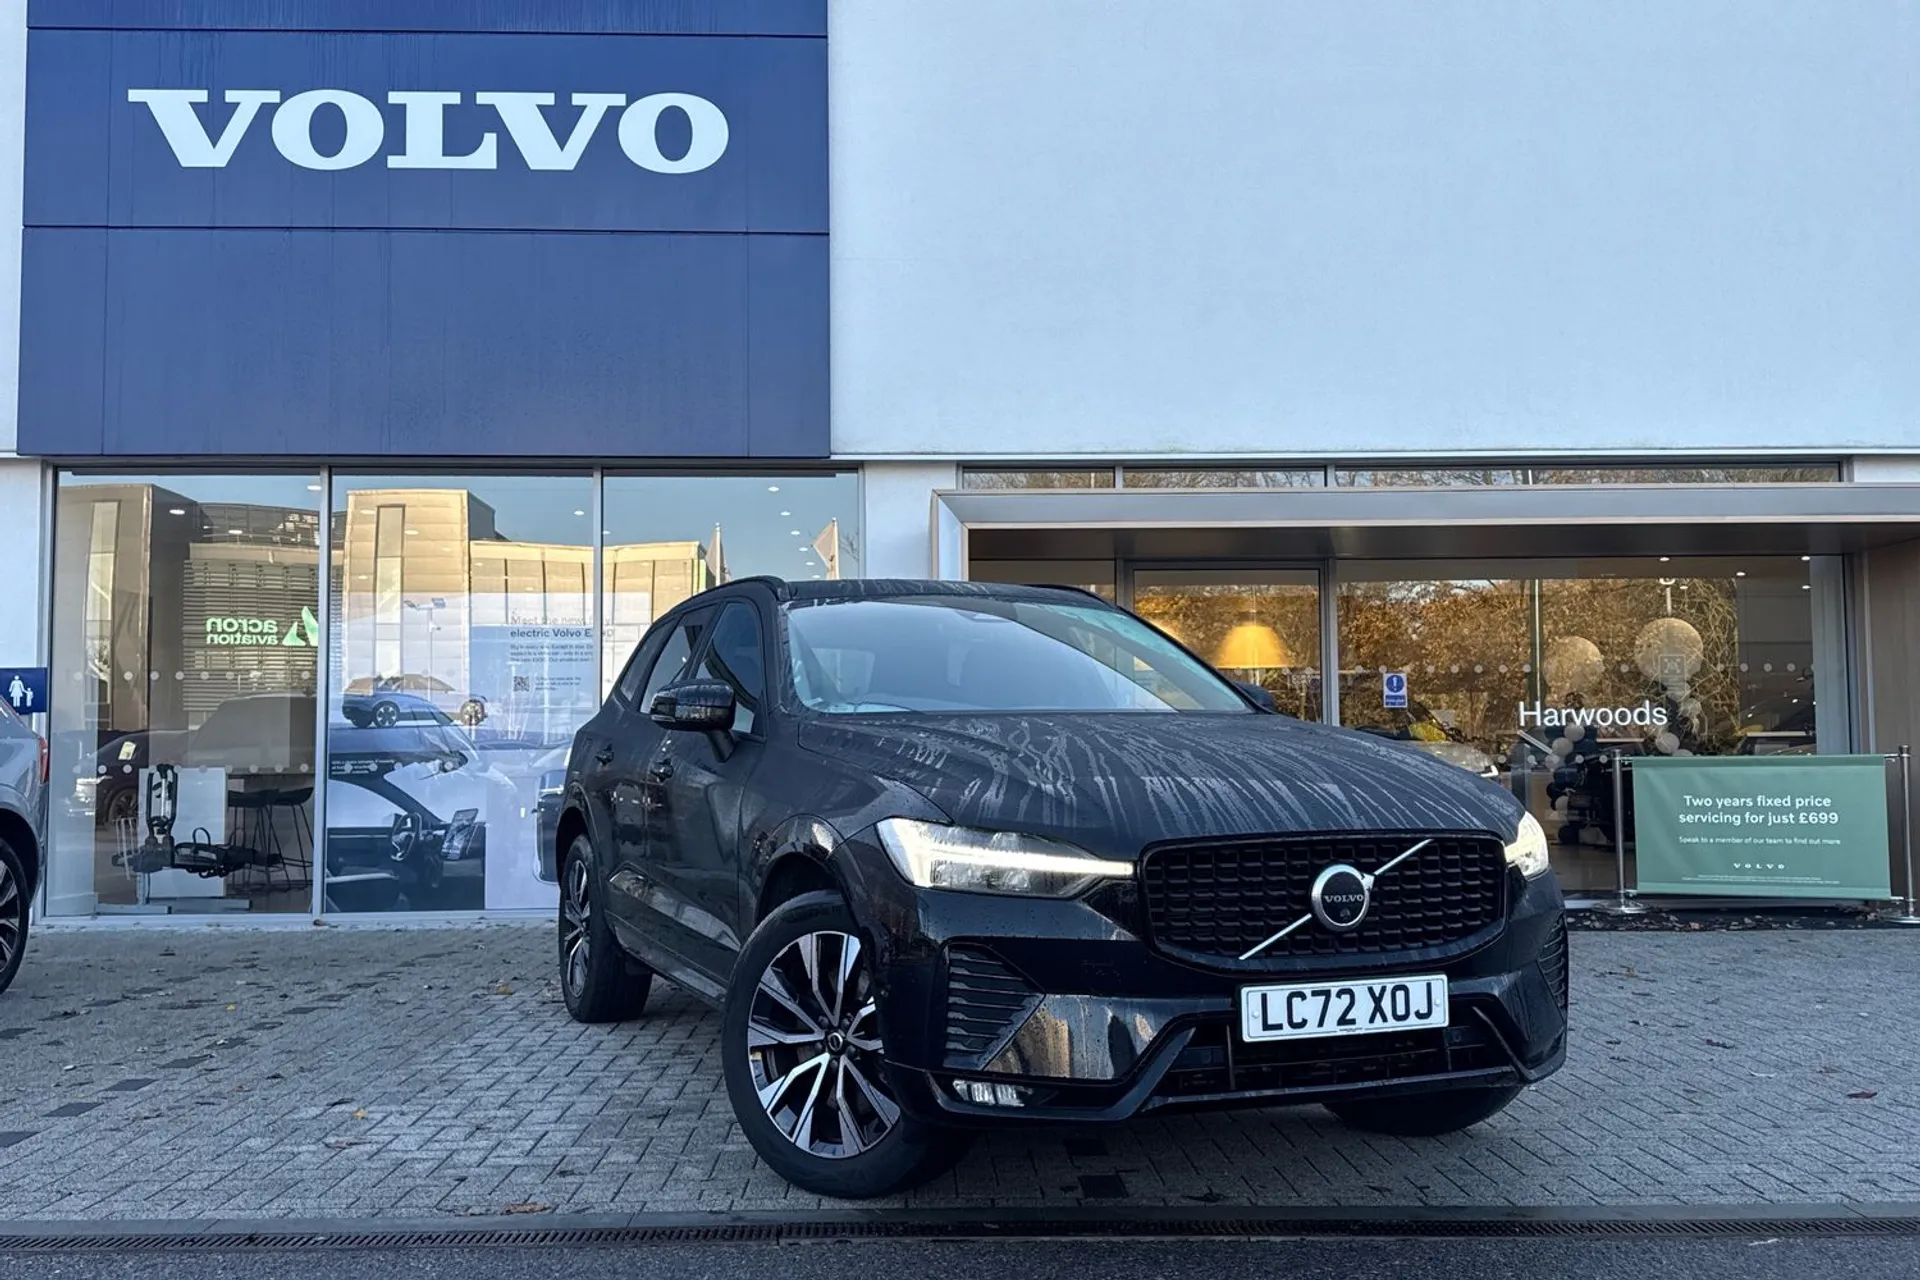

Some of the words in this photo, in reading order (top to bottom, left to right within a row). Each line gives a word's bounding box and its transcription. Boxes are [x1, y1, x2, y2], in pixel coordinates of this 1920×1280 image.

[128, 88, 730, 174] VOLVO
[510, 628, 550, 638] electric
[553, 628, 582, 638] Volvo
[1518, 699, 1668, 727] Harwoods
[1683, 795, 1713, 807] Two
[1715, 797, 1753, 809] years
[1756, 795, 1791, 807] fixed
[1795, 796, 1832, 809] price
[1679, 812, 1741, 826] servicing
[1744, 812, 1765, 824] for
[1767, 812, 1796, 826] just
[1798, 812, 1839, 824] £699
[1679, 836, 1699, 845] Speak
[1793, 837, 1807, 845] find
[1323, 893, 1364, 904] VOLVO
[1261, 988, 1357, 1032] LC72
[1367, 981, 1434, 1025] XOJ
